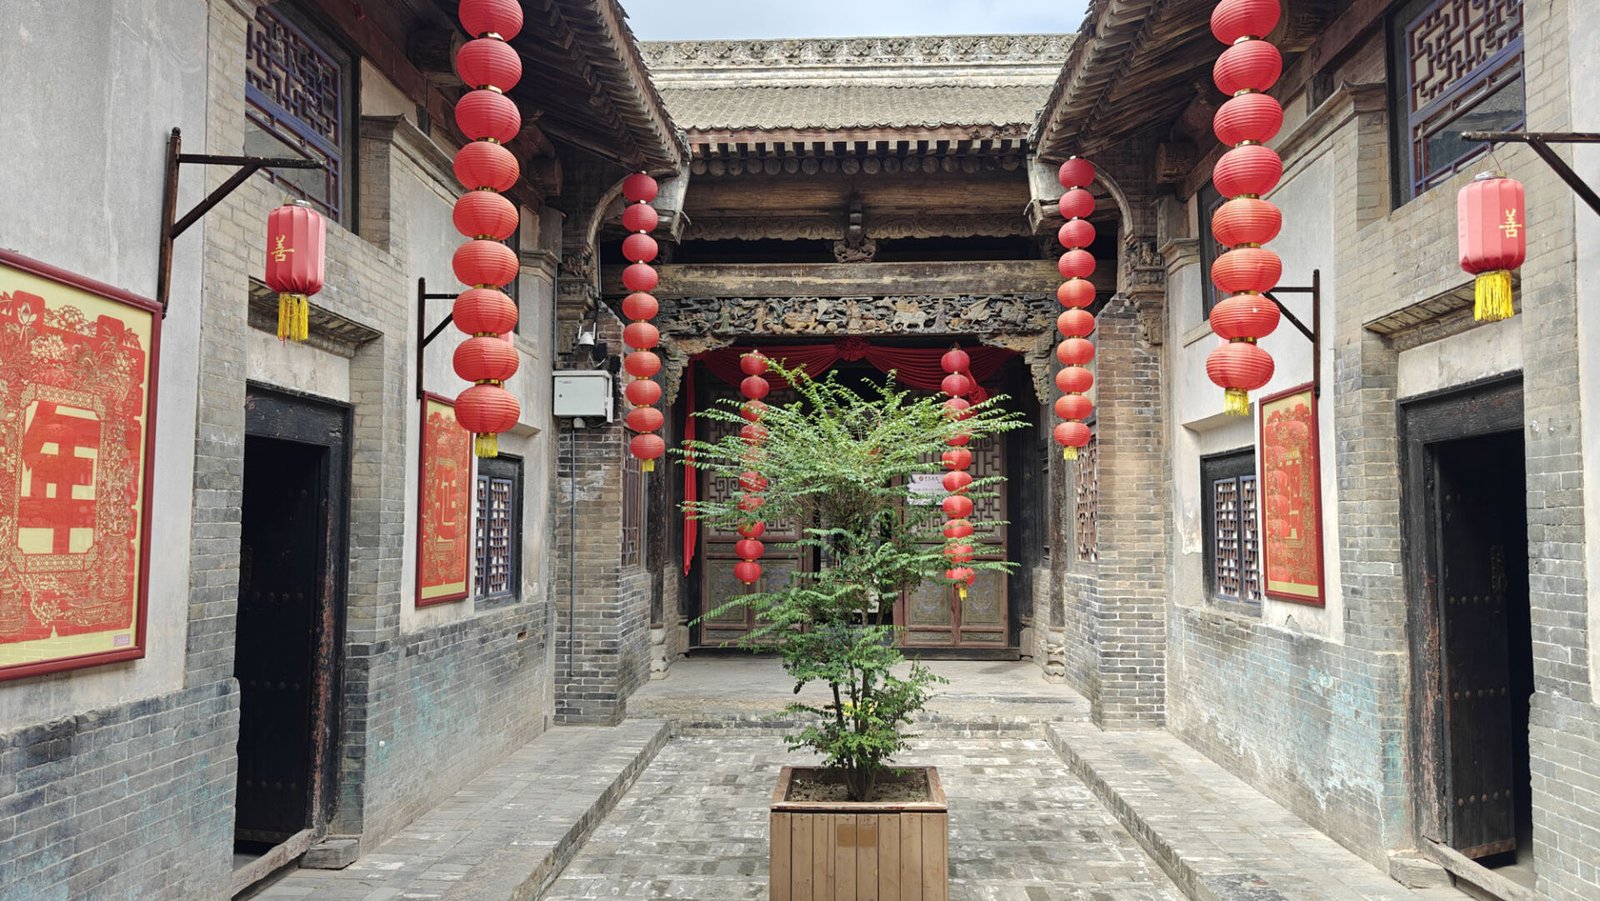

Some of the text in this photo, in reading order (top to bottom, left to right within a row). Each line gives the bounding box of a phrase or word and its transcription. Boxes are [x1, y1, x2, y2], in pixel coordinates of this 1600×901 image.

[1498, 208, 1522, 238] 善
[271, 234, 295, 263] 善
[17, 401, 100, 555] 年
